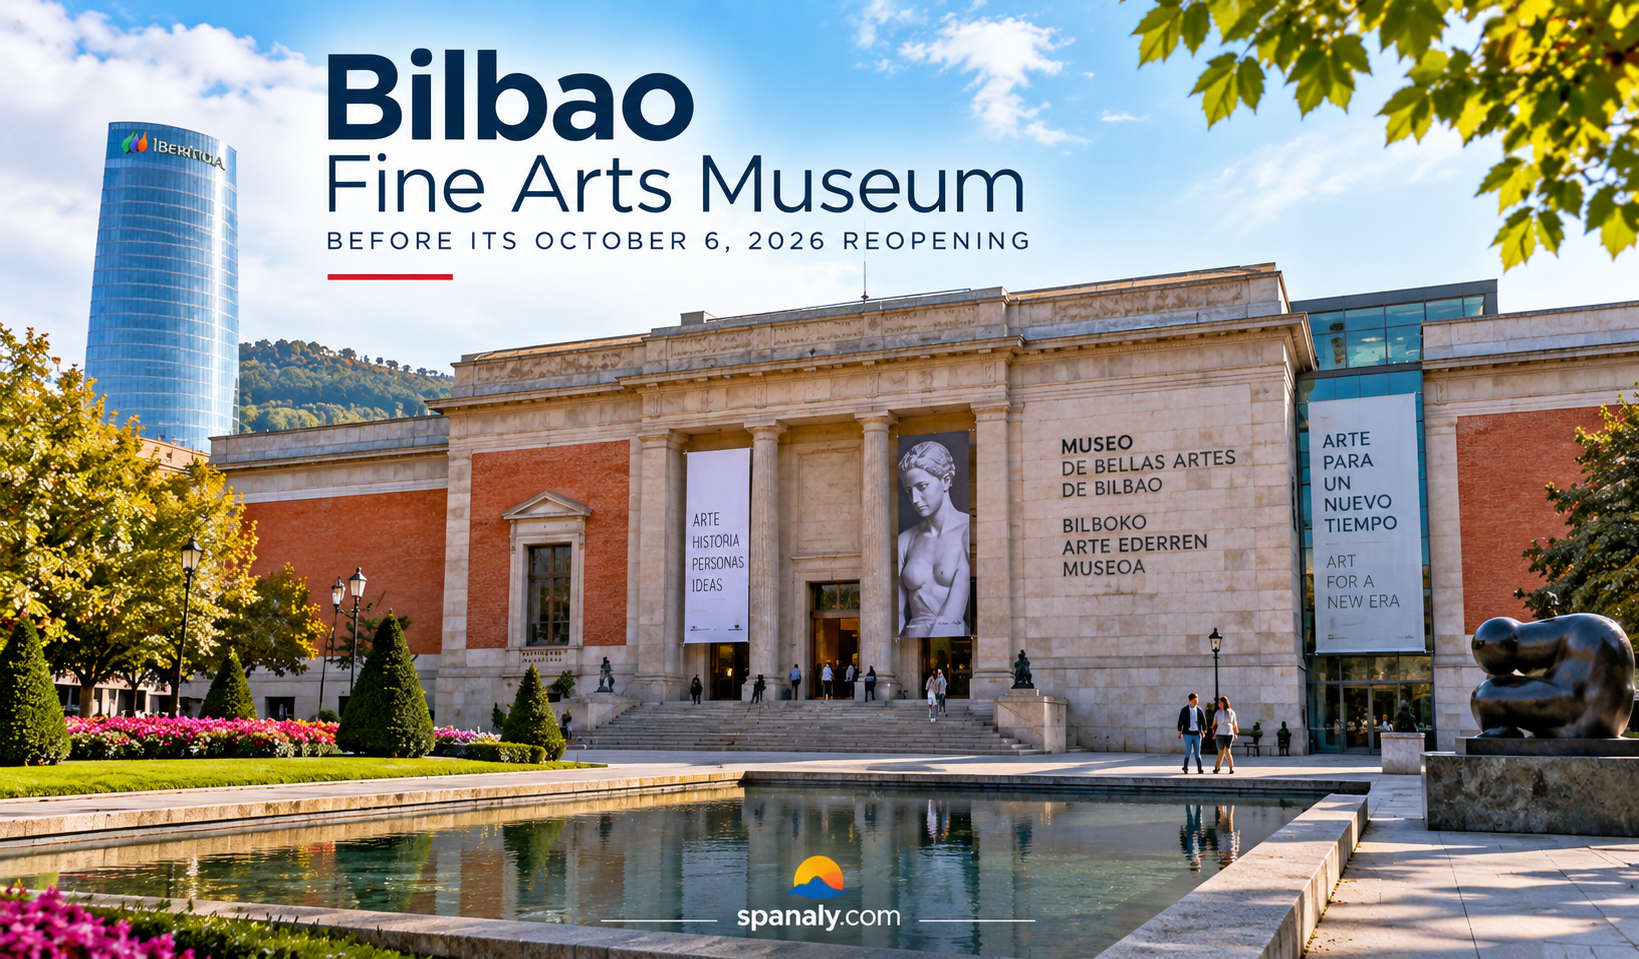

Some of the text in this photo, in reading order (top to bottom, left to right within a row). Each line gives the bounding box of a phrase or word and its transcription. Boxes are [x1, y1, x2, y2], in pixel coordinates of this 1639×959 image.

[1061, 434, 1133, 455] MUSEO
[1322, 431, 1371, 448] ARTE
[1062, 449, 1236, 477] DE BELLAS ARTES
[1323, 453, 1374, 470] PARA
[1062, 477, 1163, 497] DE BILBAO
[1324, 475, 1351, 491] UN
[1324, 494, 1392, 512] NUEVO
[692, 511, 720, 527] ARTE
[1062, 514, 1147, 533] BILBOKO
[1324, 515, 1398, 533] TIEMPO
[692, 533, 740, 549] HISTORIA
[1062, 533, 1208, 556] ARTE EDERREN
[692, 555, 744, 571] PERSONAS
[1063, 558, 1146, 577] MUSEOA
[1326, 554, 1356, 569] ART
[692, 577, 723, 593] IDEAS
[1326, 574, 1375, 589] FOR A
[1327, 593, 1400, 609] NEW ERA
